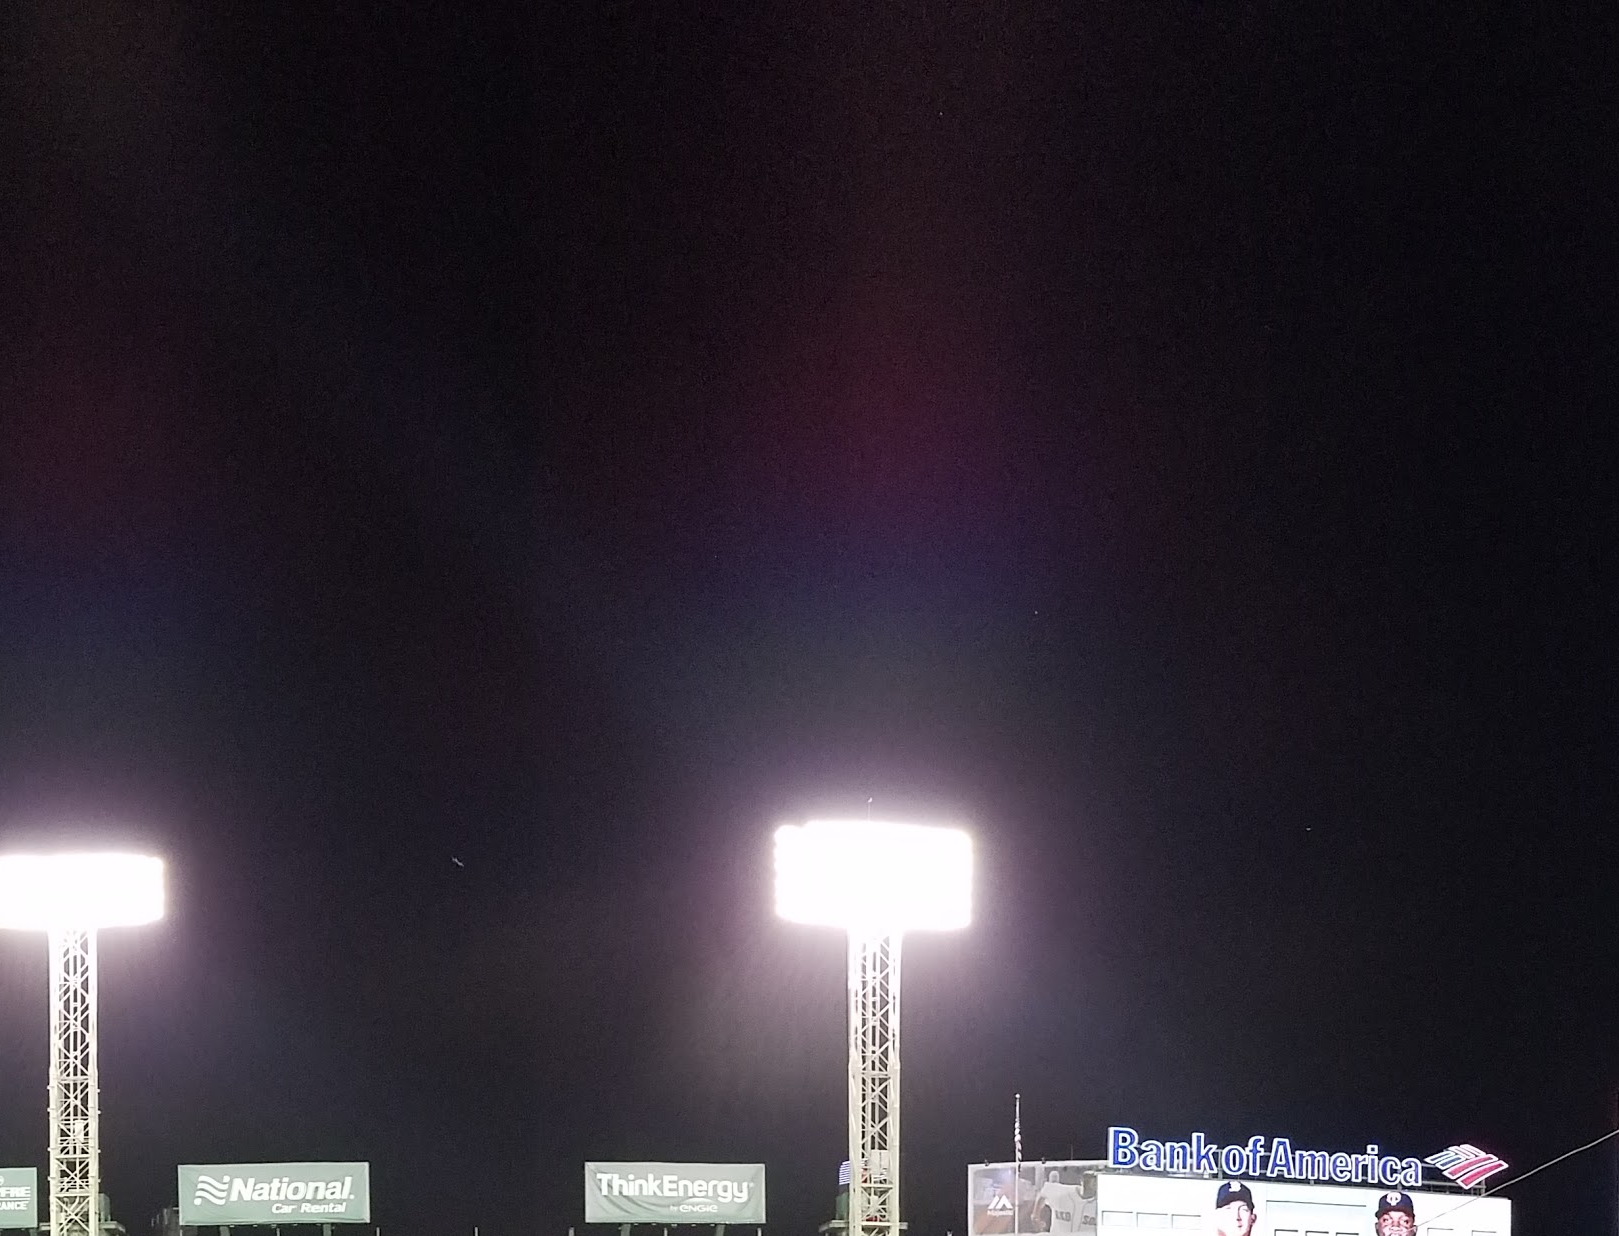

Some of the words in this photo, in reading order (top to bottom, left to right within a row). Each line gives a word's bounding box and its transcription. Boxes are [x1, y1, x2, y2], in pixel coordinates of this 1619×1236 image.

[1108, 1127, 1217, 1173] Bank
[1222, 1136, 1265, 1176] of
[1265, 1138, 1422, 1187] America
[596, 1172, 750, 1203] ThinkEnergy
[271, 1203, 296, 1213] Car
[300, 1202, 346, 1213] Rental
